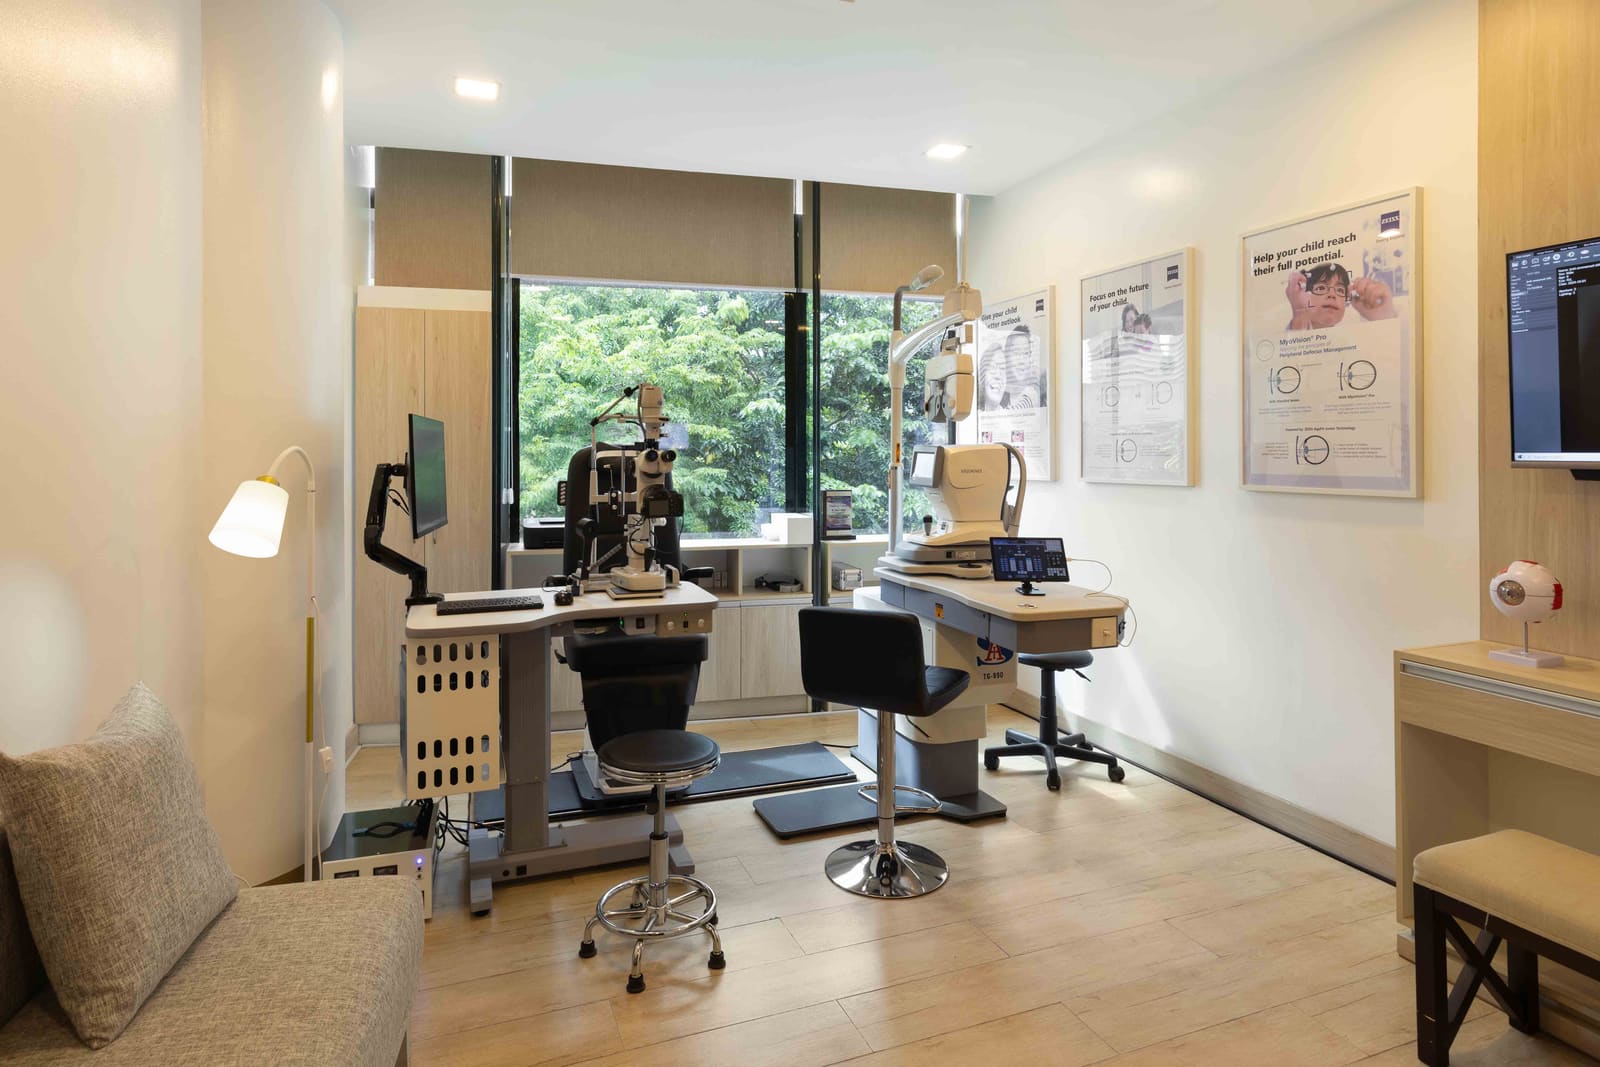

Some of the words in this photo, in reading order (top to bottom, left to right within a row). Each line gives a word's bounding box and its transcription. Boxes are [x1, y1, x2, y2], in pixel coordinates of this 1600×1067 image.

[1253, 253, 1274, 264] Help
[1276, 248, 1298, 261] your
[1300, 240, 1324, 253] child
[1327, 233, 1357, 247] reach
[1253, 265, 1275, 276] their
[1277, 260, 1292, 272] full
[1295, 249, 1344, 269] potential.
[1089, 293, 1106, 302] Focus
[1117, 287, 1128, 296] the
[1129, 283, 1150, 294] future
[992, 311, 1004, 320] your
[1005, 305, 1018, 315] child
[1089, 304, 1096, 312] of
[1097, 302, 1111, 312] your
[1001, 316, 1021, 326] outlook
